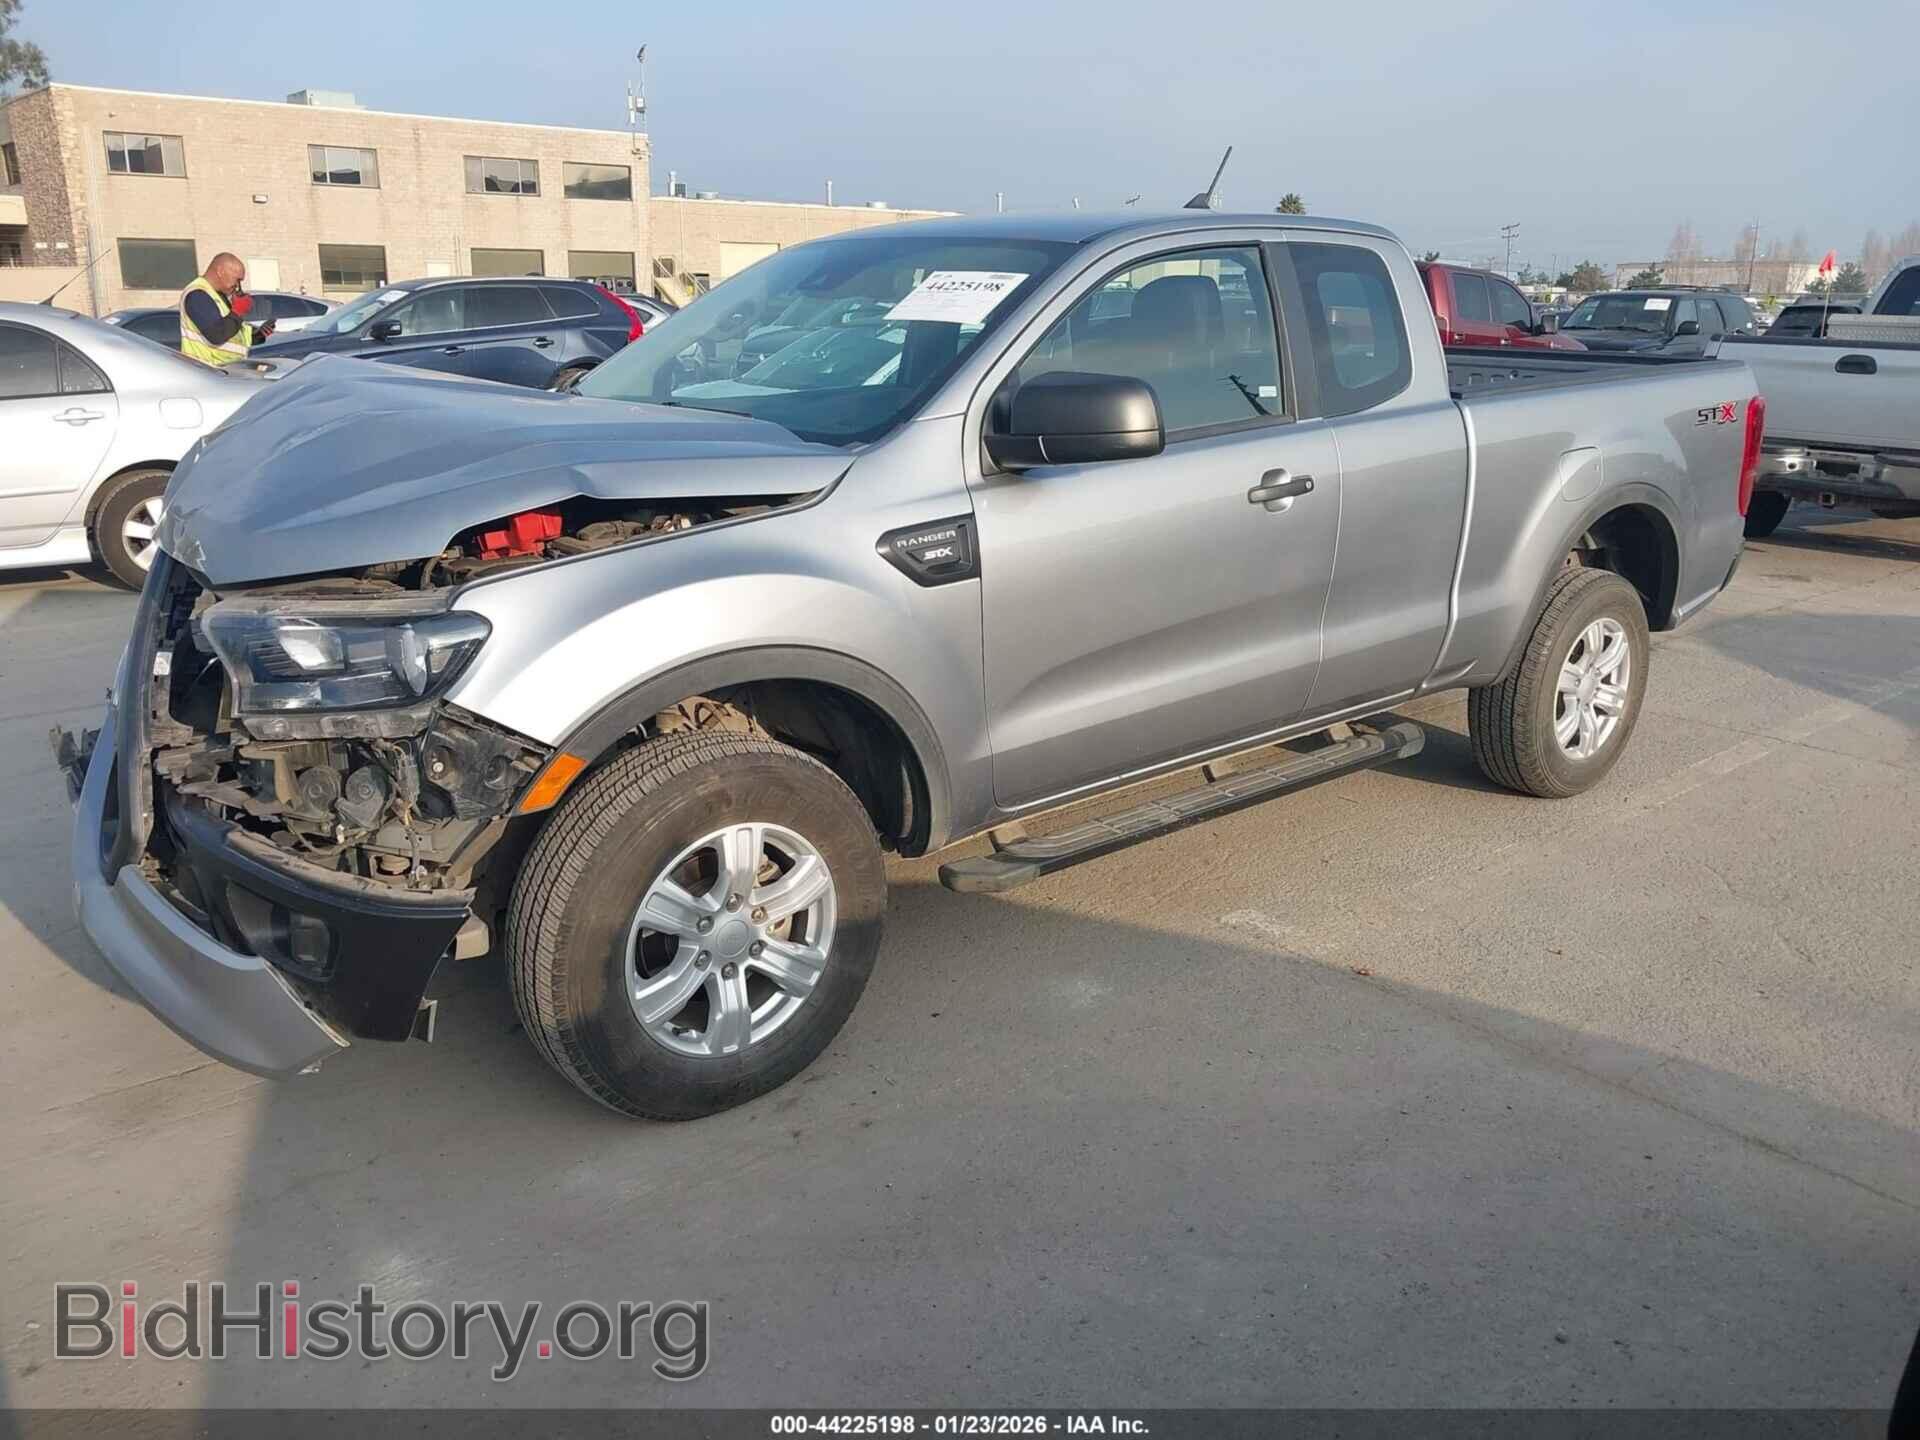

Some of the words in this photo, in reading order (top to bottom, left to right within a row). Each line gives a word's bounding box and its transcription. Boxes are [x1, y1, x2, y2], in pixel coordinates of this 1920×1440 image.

[925, 281, 1005, 292] 44225198
[1695, 401, 1737, 425] STX
[896, 529, 957, 548] RANGER
[922, 546, 954, 561] STX
